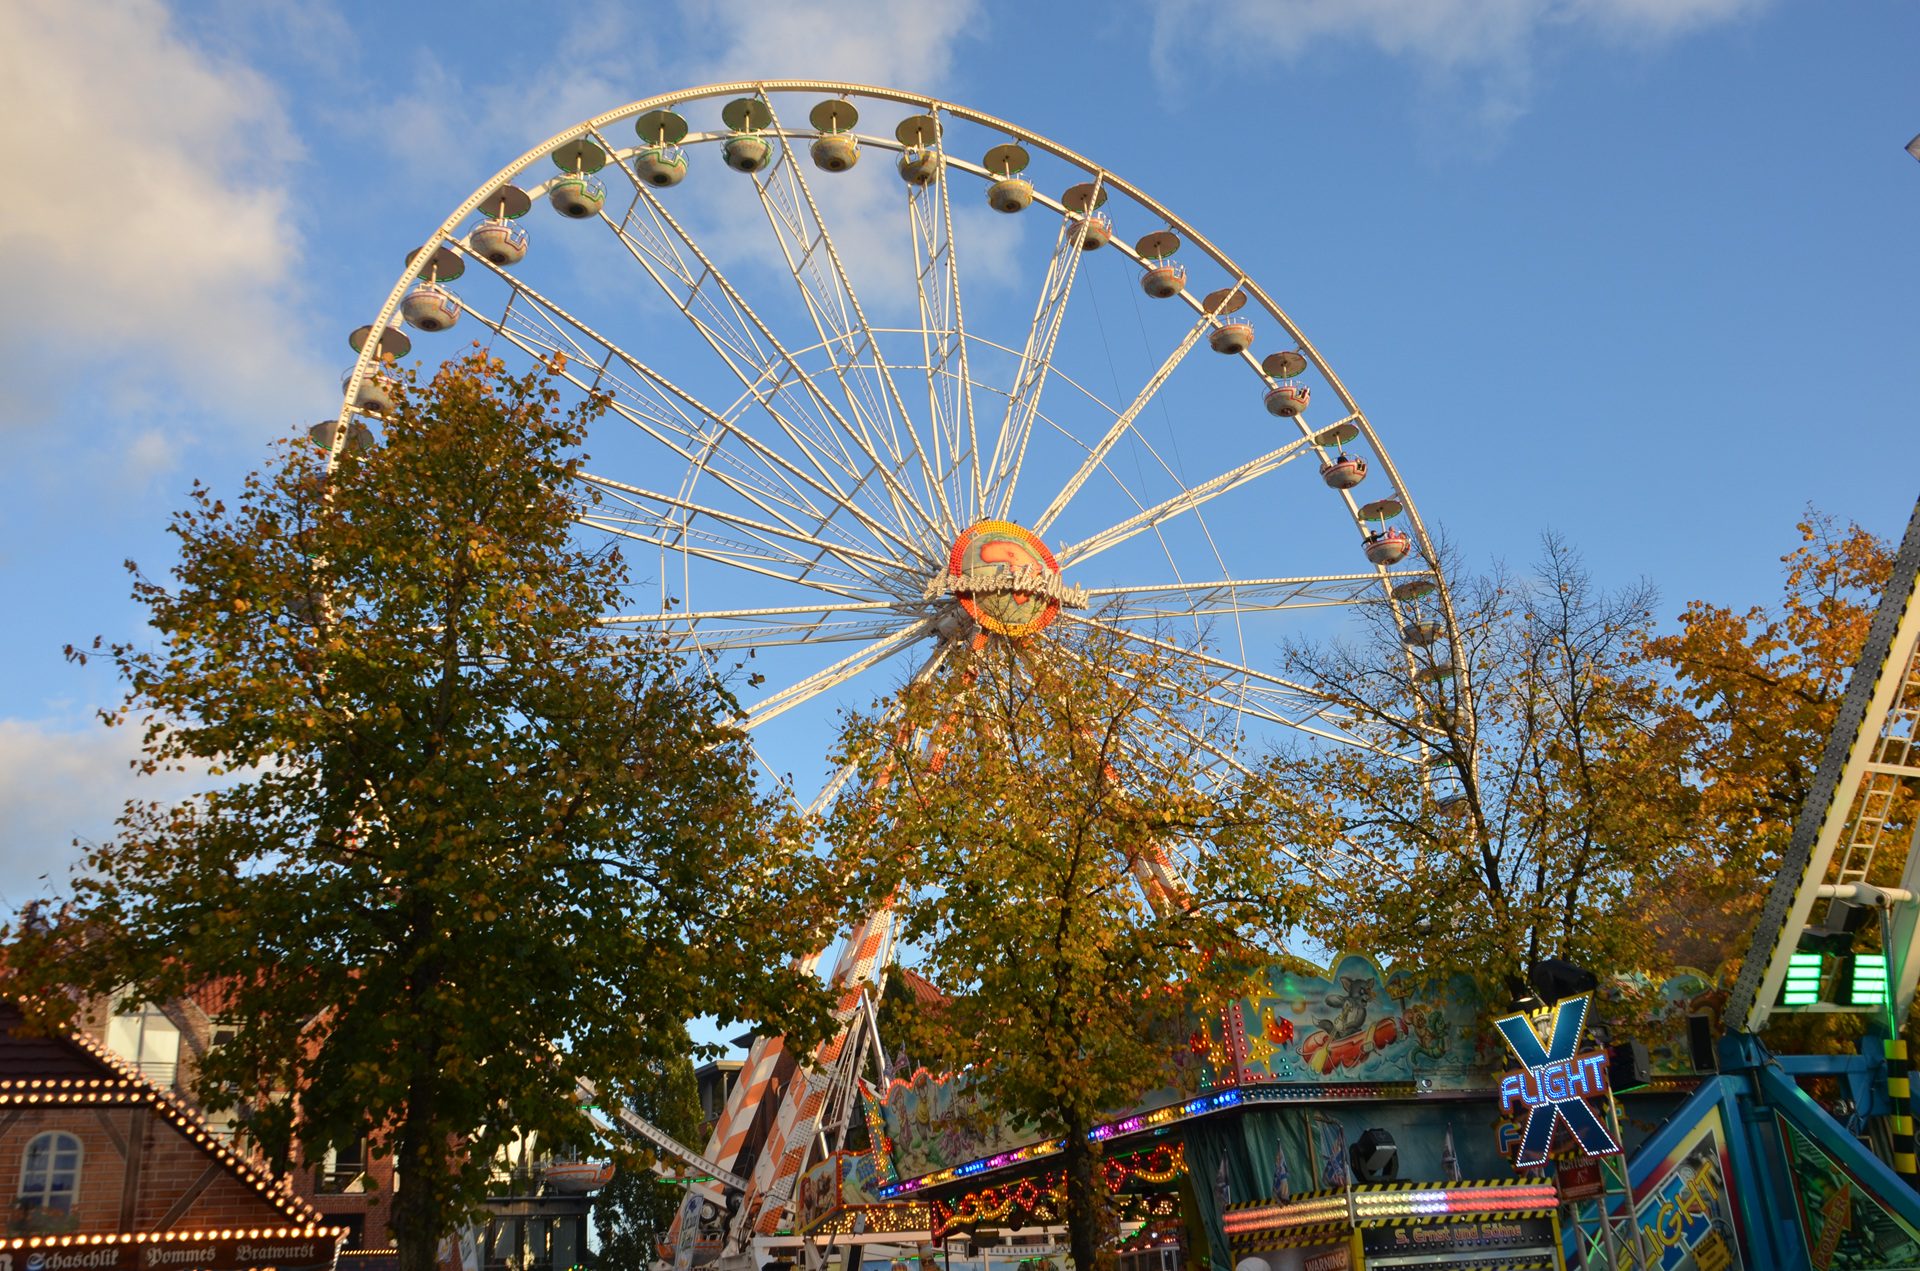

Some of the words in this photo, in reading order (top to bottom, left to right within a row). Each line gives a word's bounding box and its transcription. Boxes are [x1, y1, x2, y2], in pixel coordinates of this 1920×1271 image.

[1501, 1054, 1605, 1110] FLIGHT
[1454, 1225, 1478, 1240] und
[27, 1250, 119, 1271] Schaschlik
[147, 1247, 216, 1266] Pommes
[235, 1244, 315, 1261] Bratwurst
[1305, 1252, 1345, 1271] WARNING
